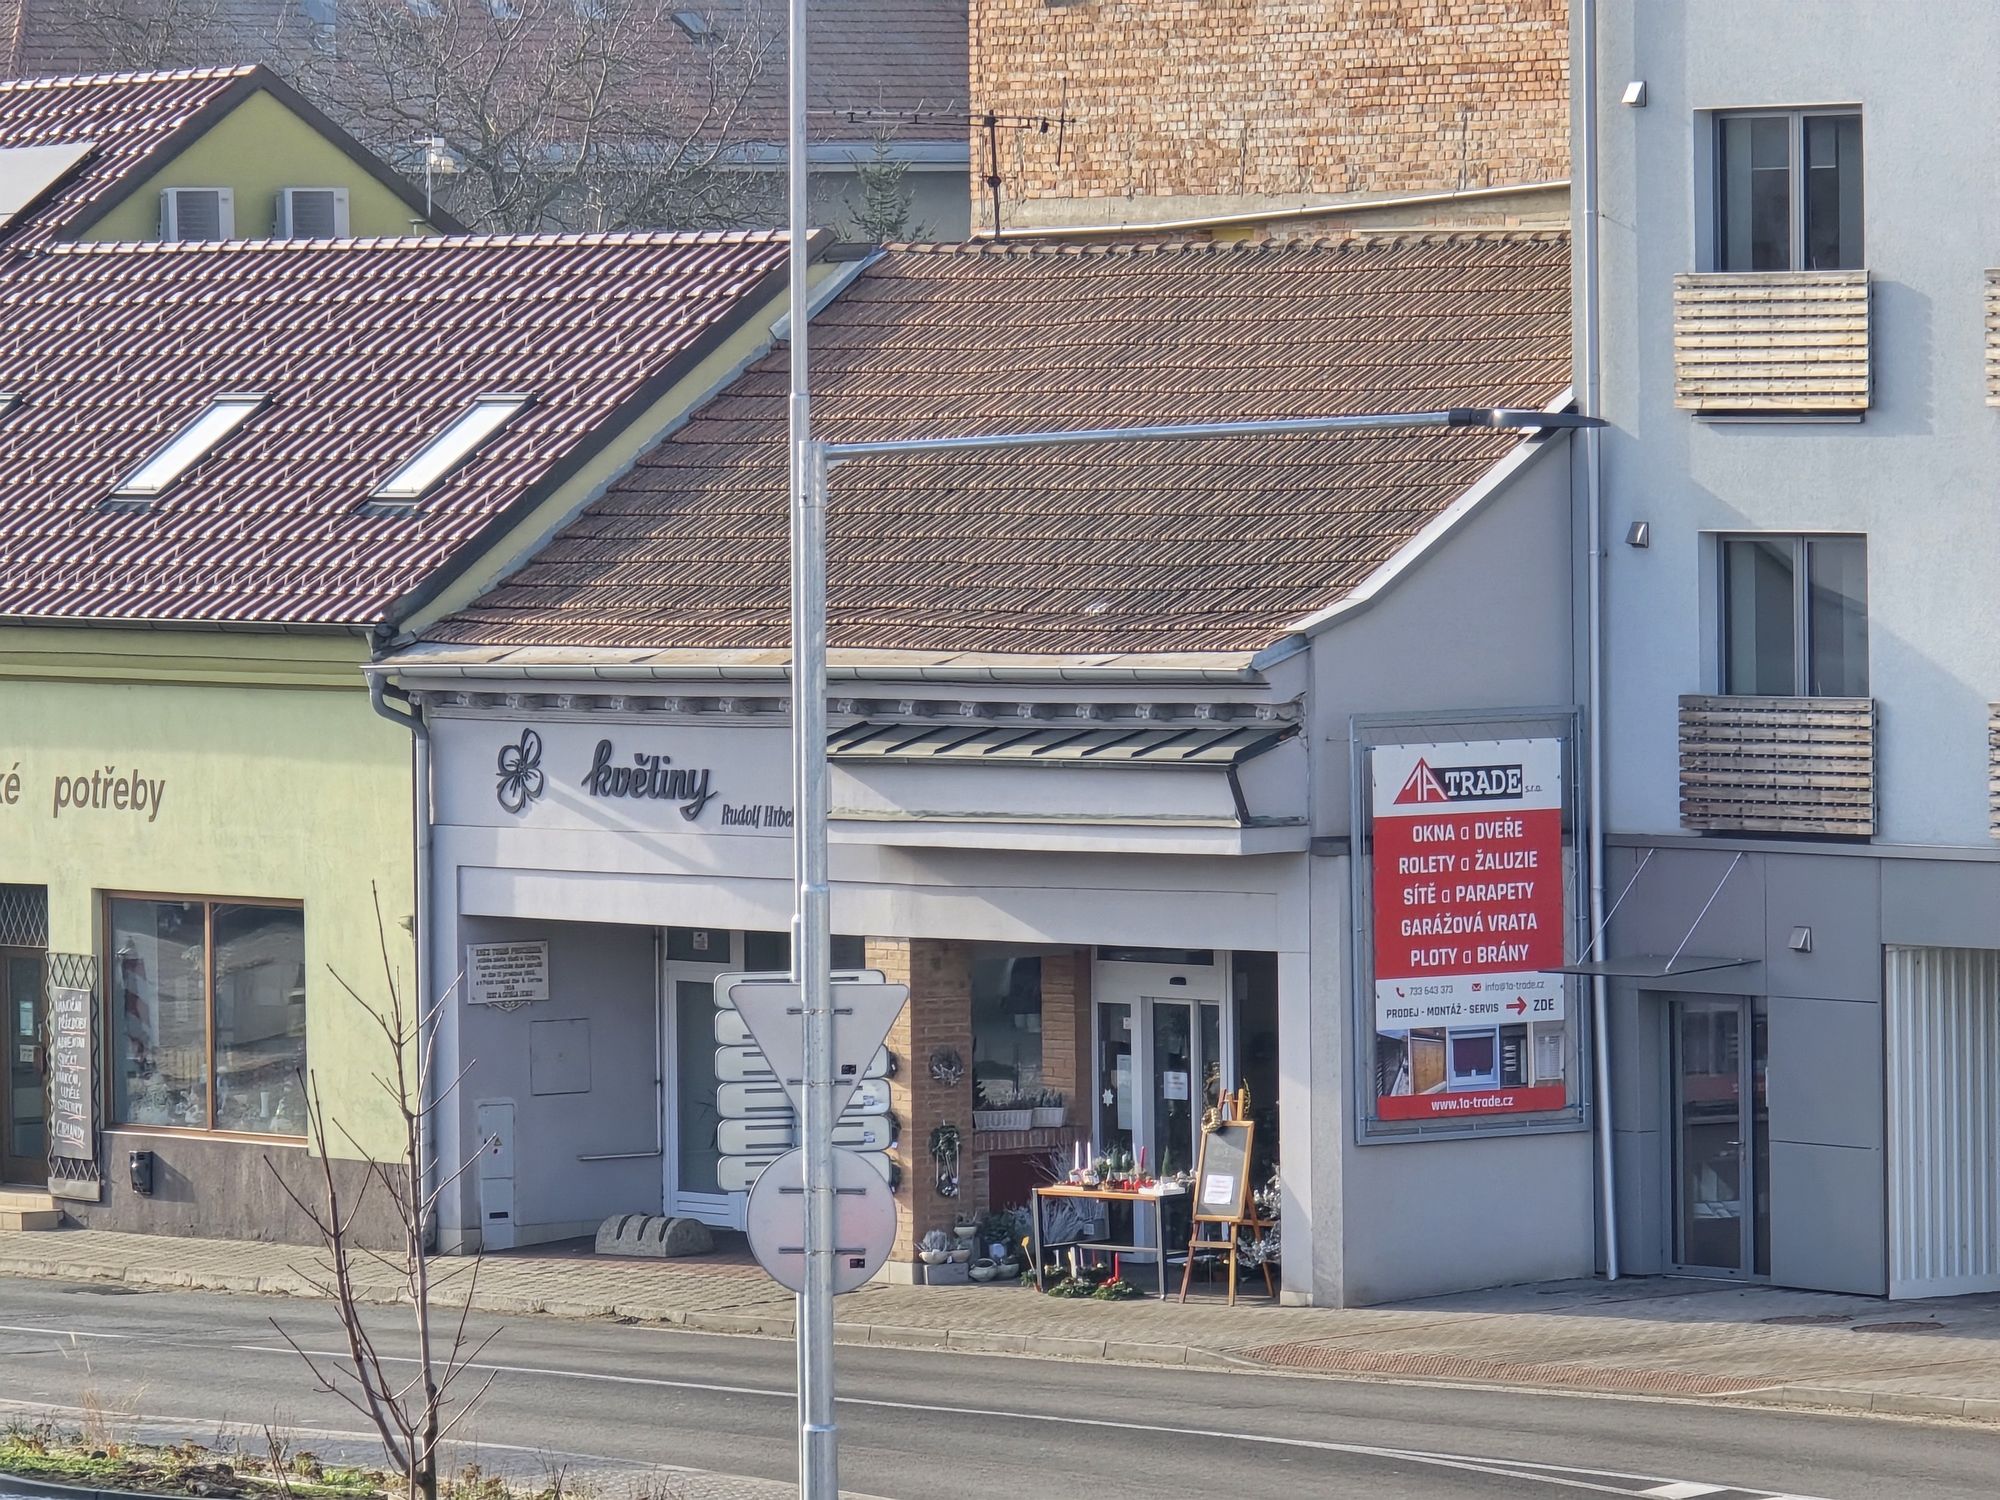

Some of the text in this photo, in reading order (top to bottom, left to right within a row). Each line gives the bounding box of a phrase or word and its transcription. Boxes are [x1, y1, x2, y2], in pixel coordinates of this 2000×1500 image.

[581, 739, 718, 821] květiny
[1445, 769, 1522, 796] TRADE
[53, 766, 165, 822] potřeby
[721, 804, 762, 829] Rudolf
[1413, 824, 1455, 842] OKNA
[1475, 817, 1523, 840] DVEŘE
[1400, 855, 1455, 874] ROLETY
[1475, 849, 1537, 871] ŽALUZIE
[1403, 882, 1436, 905] SÍTĚ
[1456, 882, 1534, 902] PARAPETY
[1401, 911, 1537, 936] GARÁŽOVÁ VRATA
[1411, 948, 1456, 967] PLOTY
[1477, 941, 1528, 963] BRÁNY
[1409, 986, 1423, 995] 733
[1440, 985, 1453, 994] 373
[1386, 1008, 1419, 1019] PRODEJ
[1427, 1003, 1462, 1016] MONTÁŽ
[1469, 1003, 1499, 1014] SERVIS
[1533, 998, 1555, 1011] ZDE
[1431, 1095, 1514, 1111] www.1a-trade.cz
